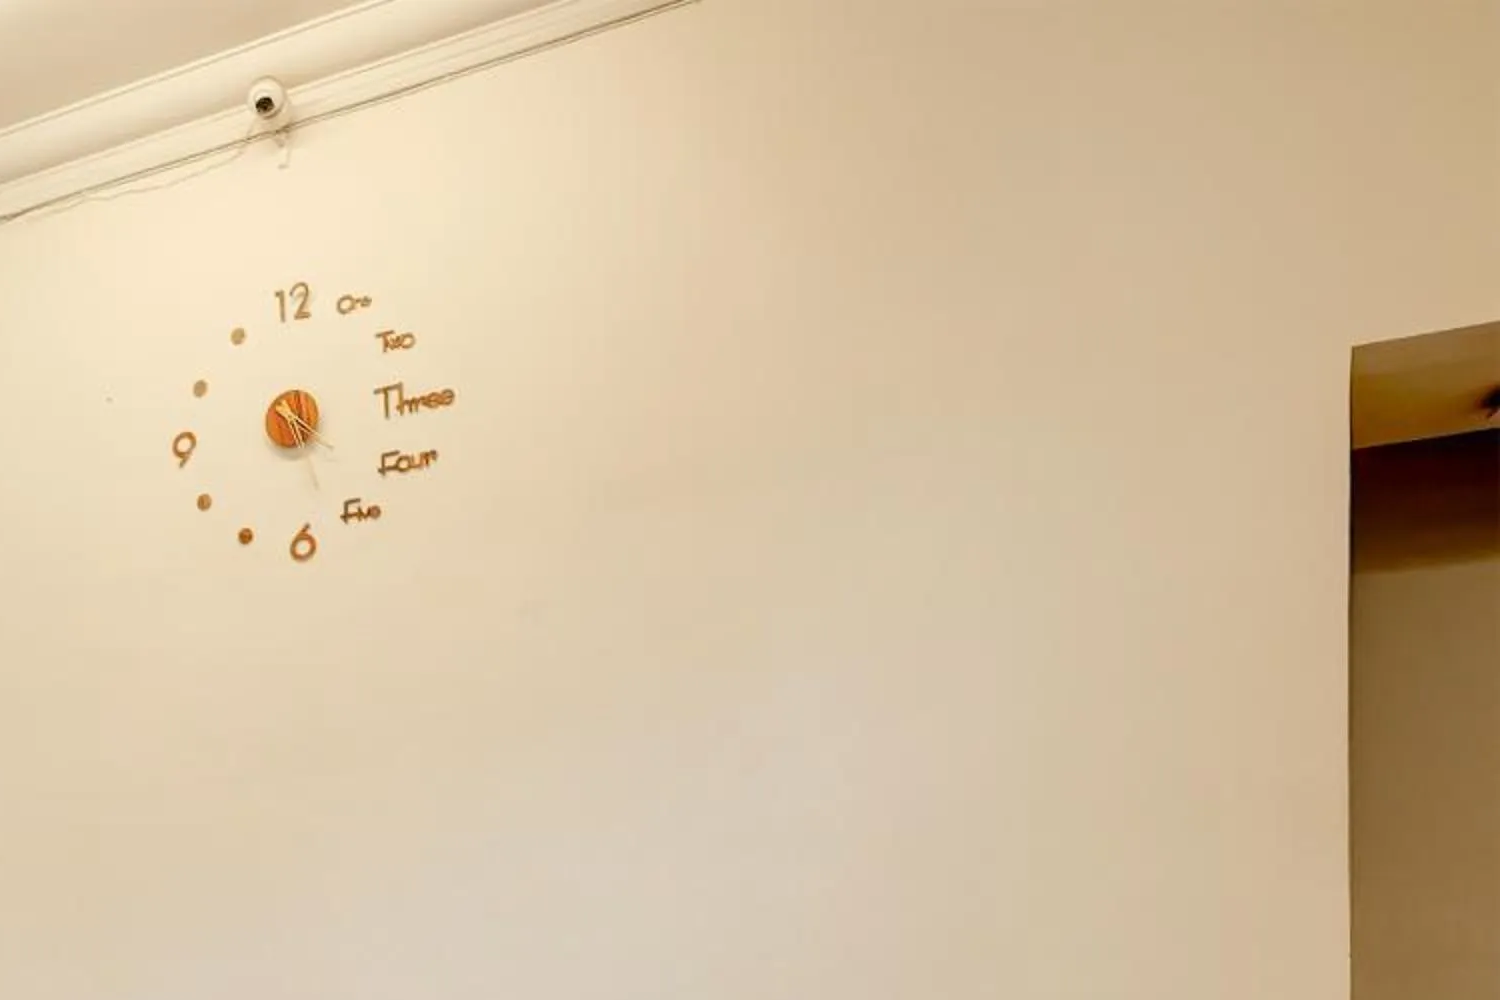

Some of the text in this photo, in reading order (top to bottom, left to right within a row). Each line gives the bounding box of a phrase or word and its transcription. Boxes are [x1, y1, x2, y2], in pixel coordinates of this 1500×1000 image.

[274, 281, 311, 322] 12
[373, 382, 456, 420] Three
[172, 431, 197, 468] 9
[290, 523, 317, 562] 6
